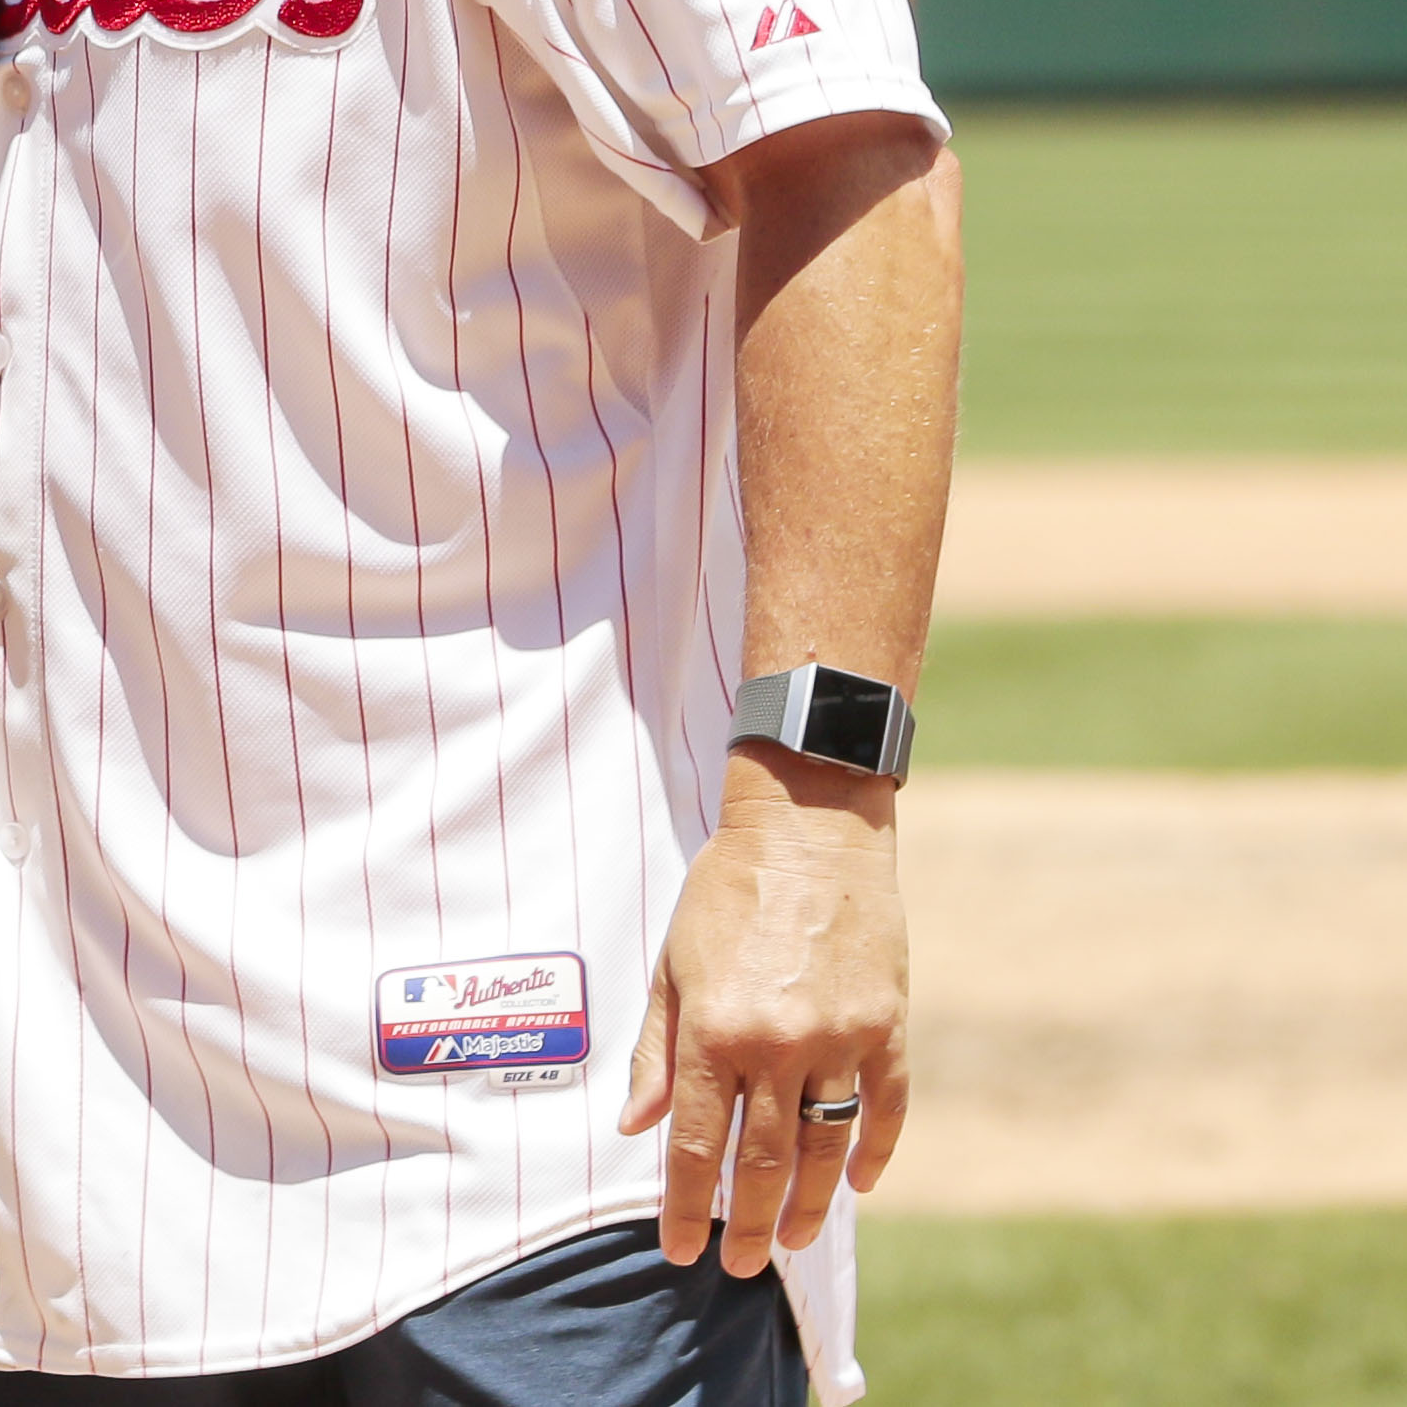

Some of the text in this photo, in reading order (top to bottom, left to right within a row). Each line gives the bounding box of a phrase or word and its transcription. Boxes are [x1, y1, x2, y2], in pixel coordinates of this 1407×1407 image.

[453, 966, 556, 1010] Authentic
[391, 1012, 571, 1036] PERFORMANCE APPAREL
[462, 1032, 546, 1060] Majestic
[502, 1071, 534, 1083] SIZE
